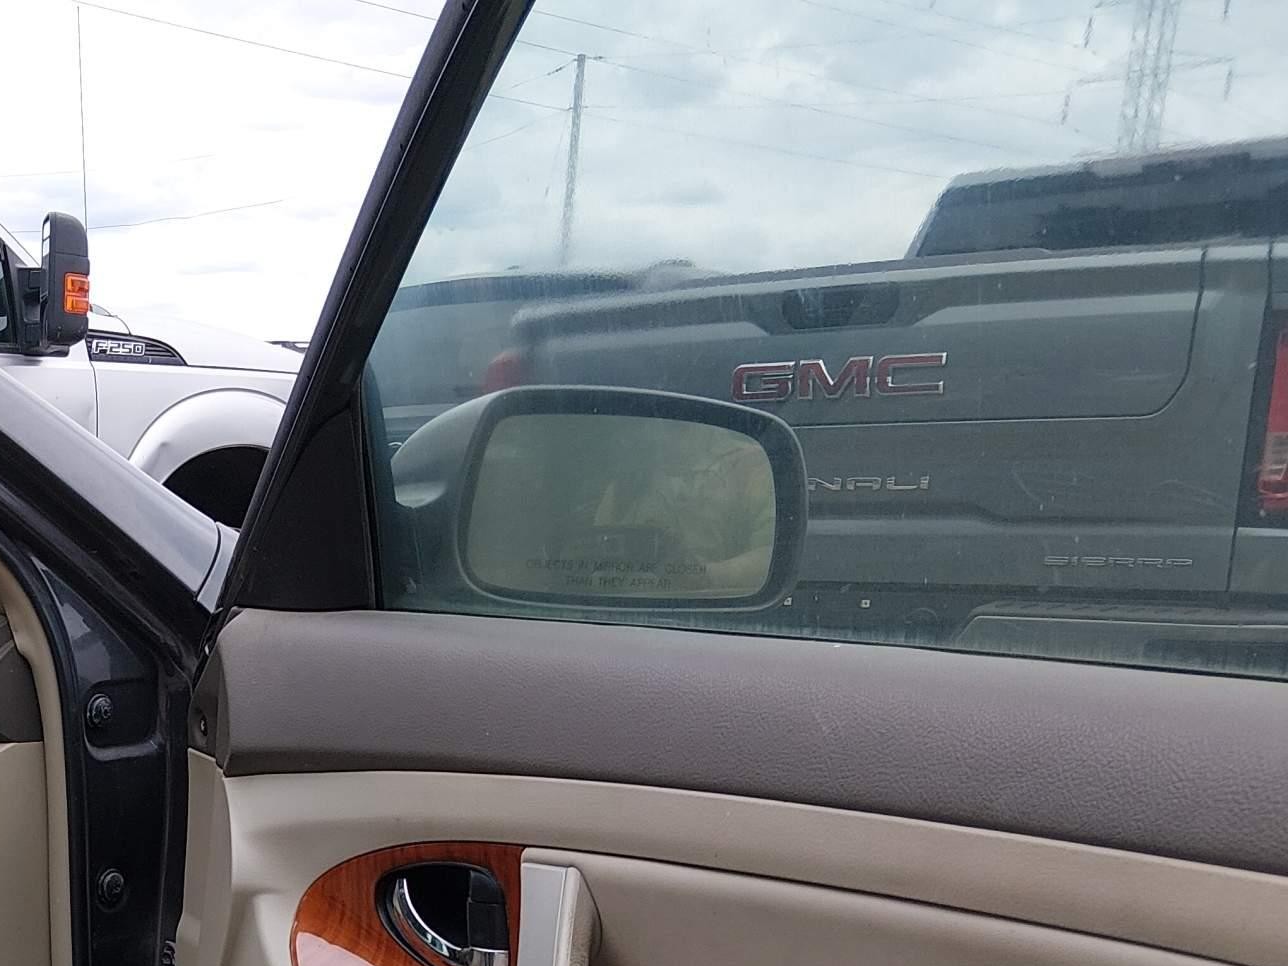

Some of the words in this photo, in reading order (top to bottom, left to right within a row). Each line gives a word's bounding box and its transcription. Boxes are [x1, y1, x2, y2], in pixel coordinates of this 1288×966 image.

[93, 339, 145, 356] F-250
[732, 352, 947, 400] GMC
[807, 476, 929, 491] NALI
[1044, 556, 1193, 568] SIERRA
